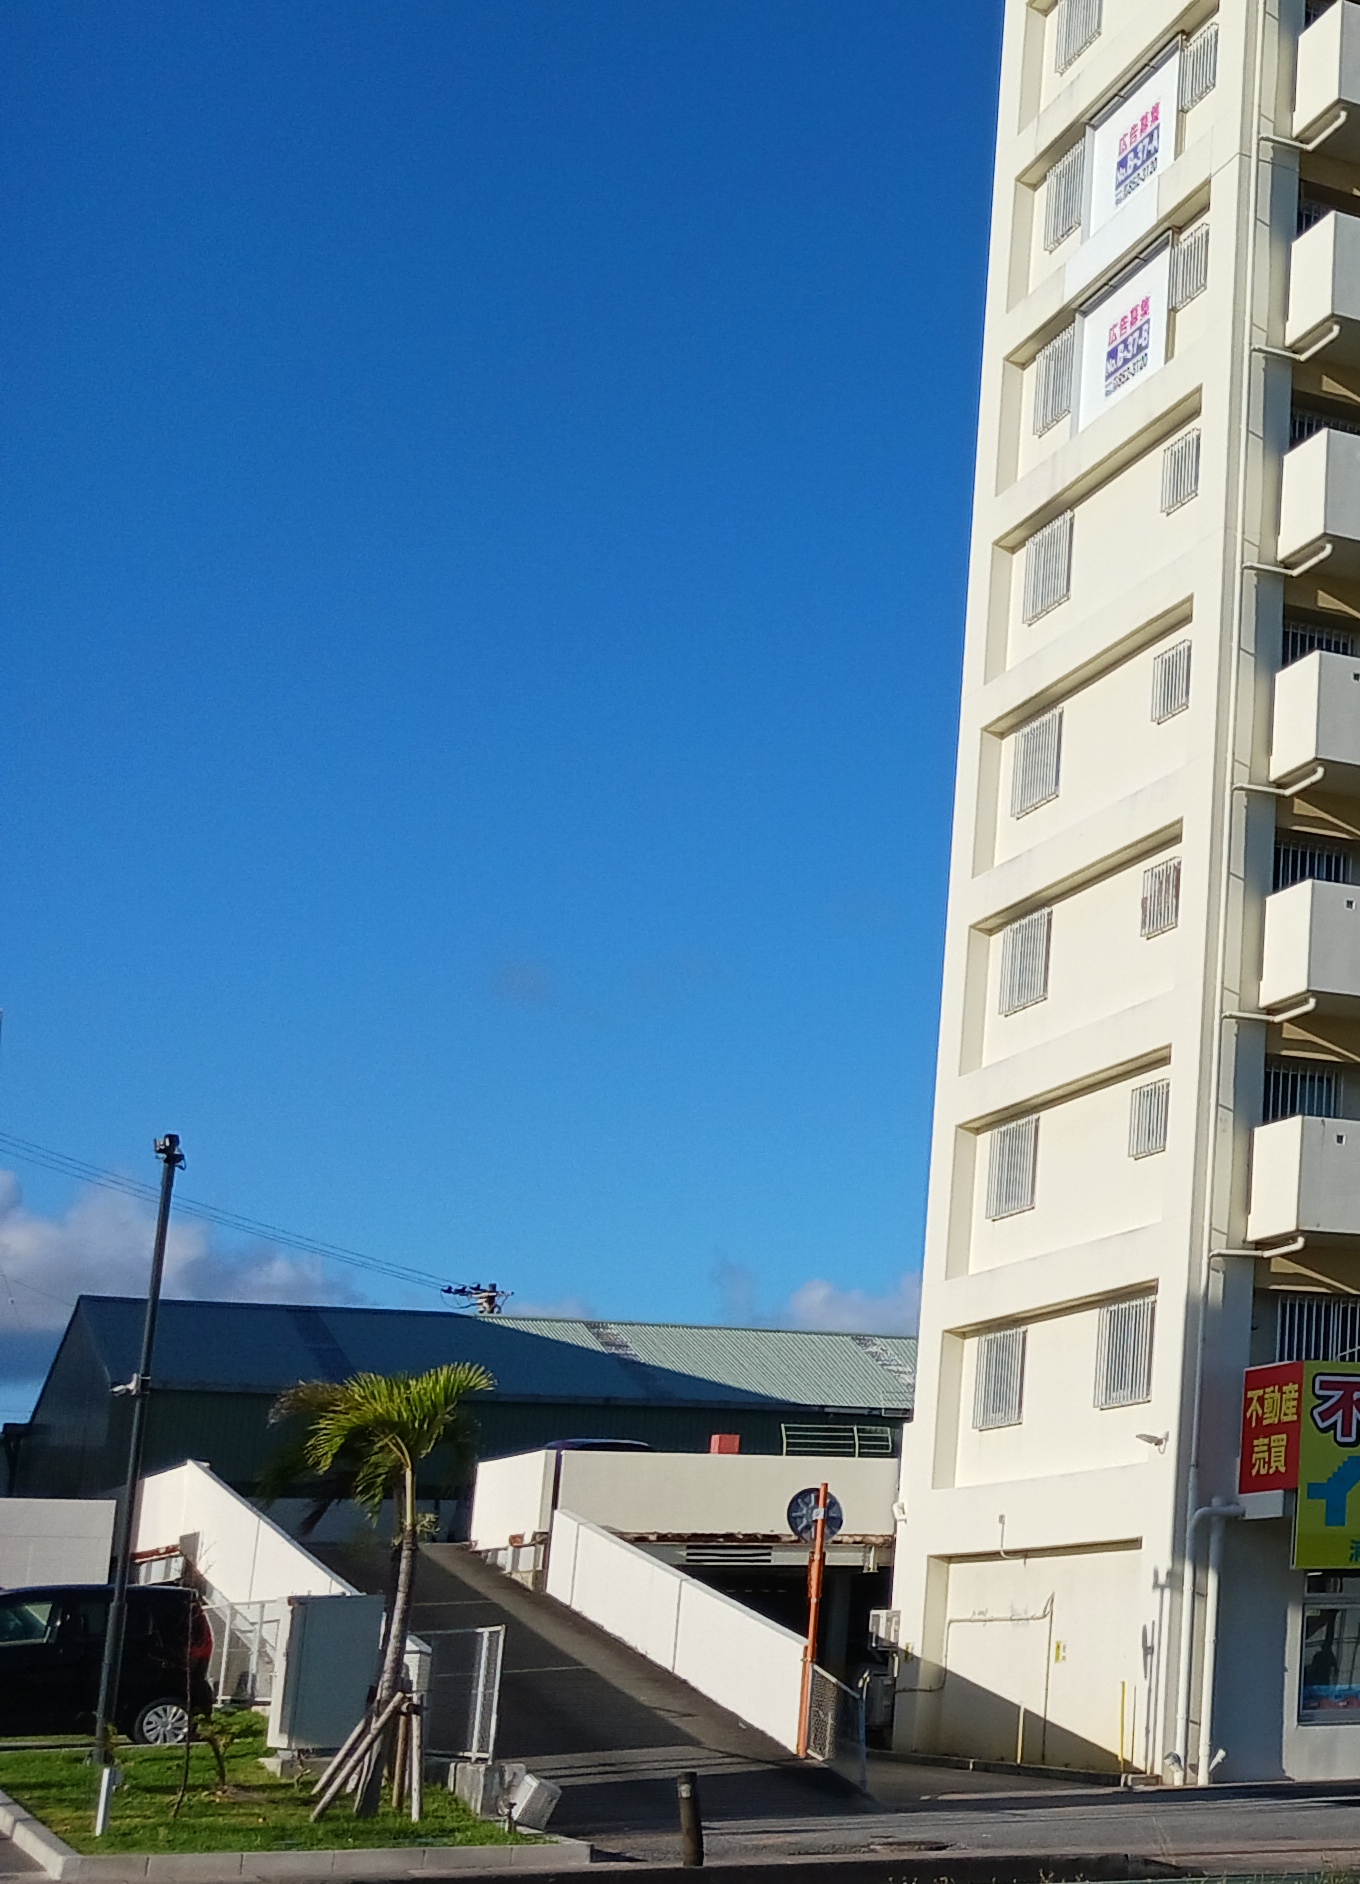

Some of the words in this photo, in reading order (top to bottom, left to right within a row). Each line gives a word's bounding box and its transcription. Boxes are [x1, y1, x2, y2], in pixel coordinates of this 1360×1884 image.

[1246, 1382, 1299, 1428] 不動産
[1252, 1434, 1287, 1477] 売買
